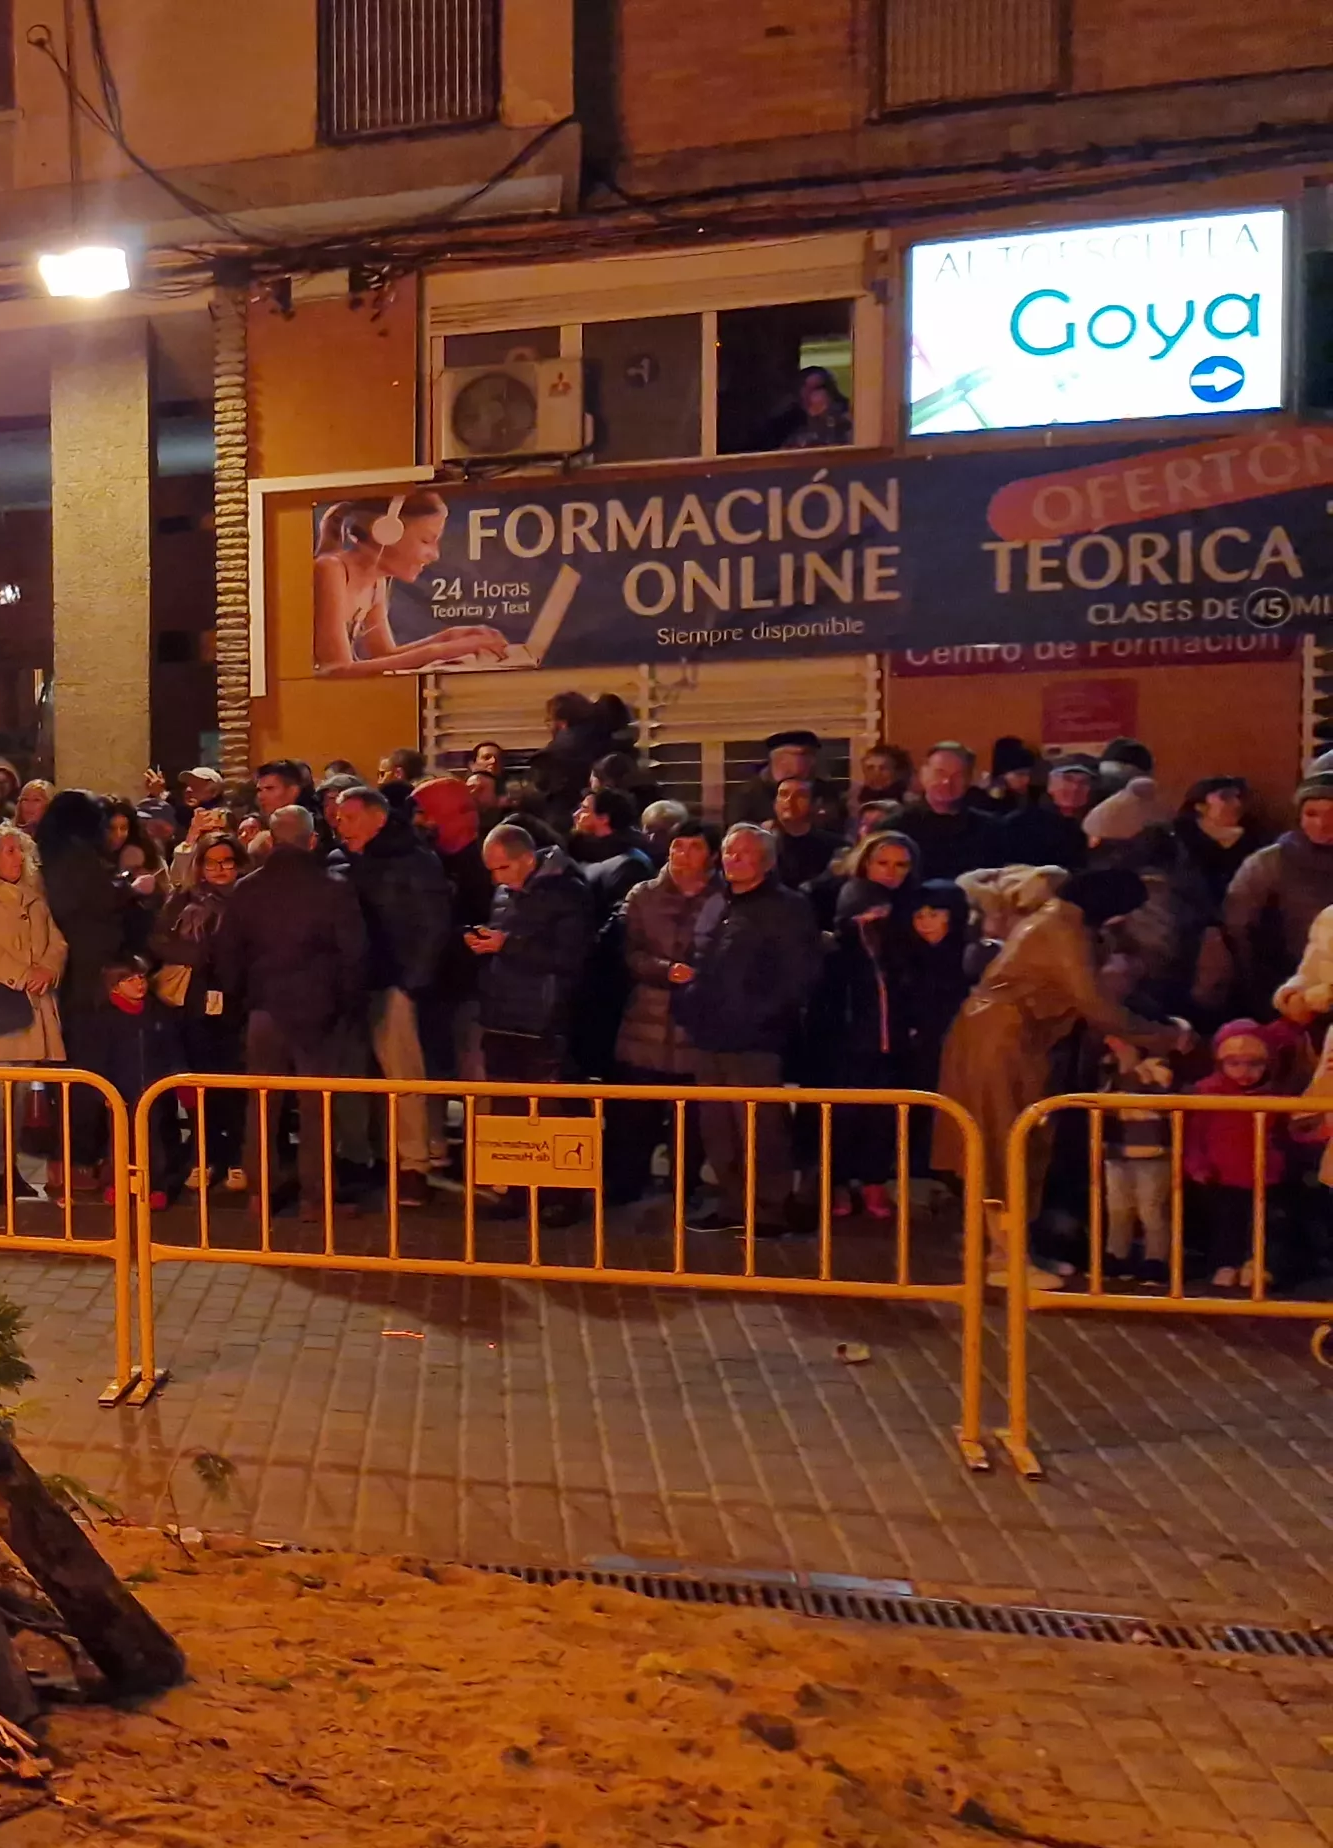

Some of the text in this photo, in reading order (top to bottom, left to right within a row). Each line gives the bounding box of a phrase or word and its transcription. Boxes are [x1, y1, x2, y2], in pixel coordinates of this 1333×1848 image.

[1009, 288, 1261, 361] Goya
[468, 468, 901, 560] FORMACIÓN
[431, 577, 531, 600] 24 Horas
[621, 546, 902, 616] ONLINE
[487, 603, 498, 619] y
[501, 600, 530, 614] Test
[1087, 599, 1193, 626] CLASES
[1202, 597, 1241, 621] DE
[1252, 597, 1284, 619] 45
[657, 616, 865, 647] Siempre disponible
[905, 643, 1021, 666] Centro
[1034, 640, 1077, 660] de
